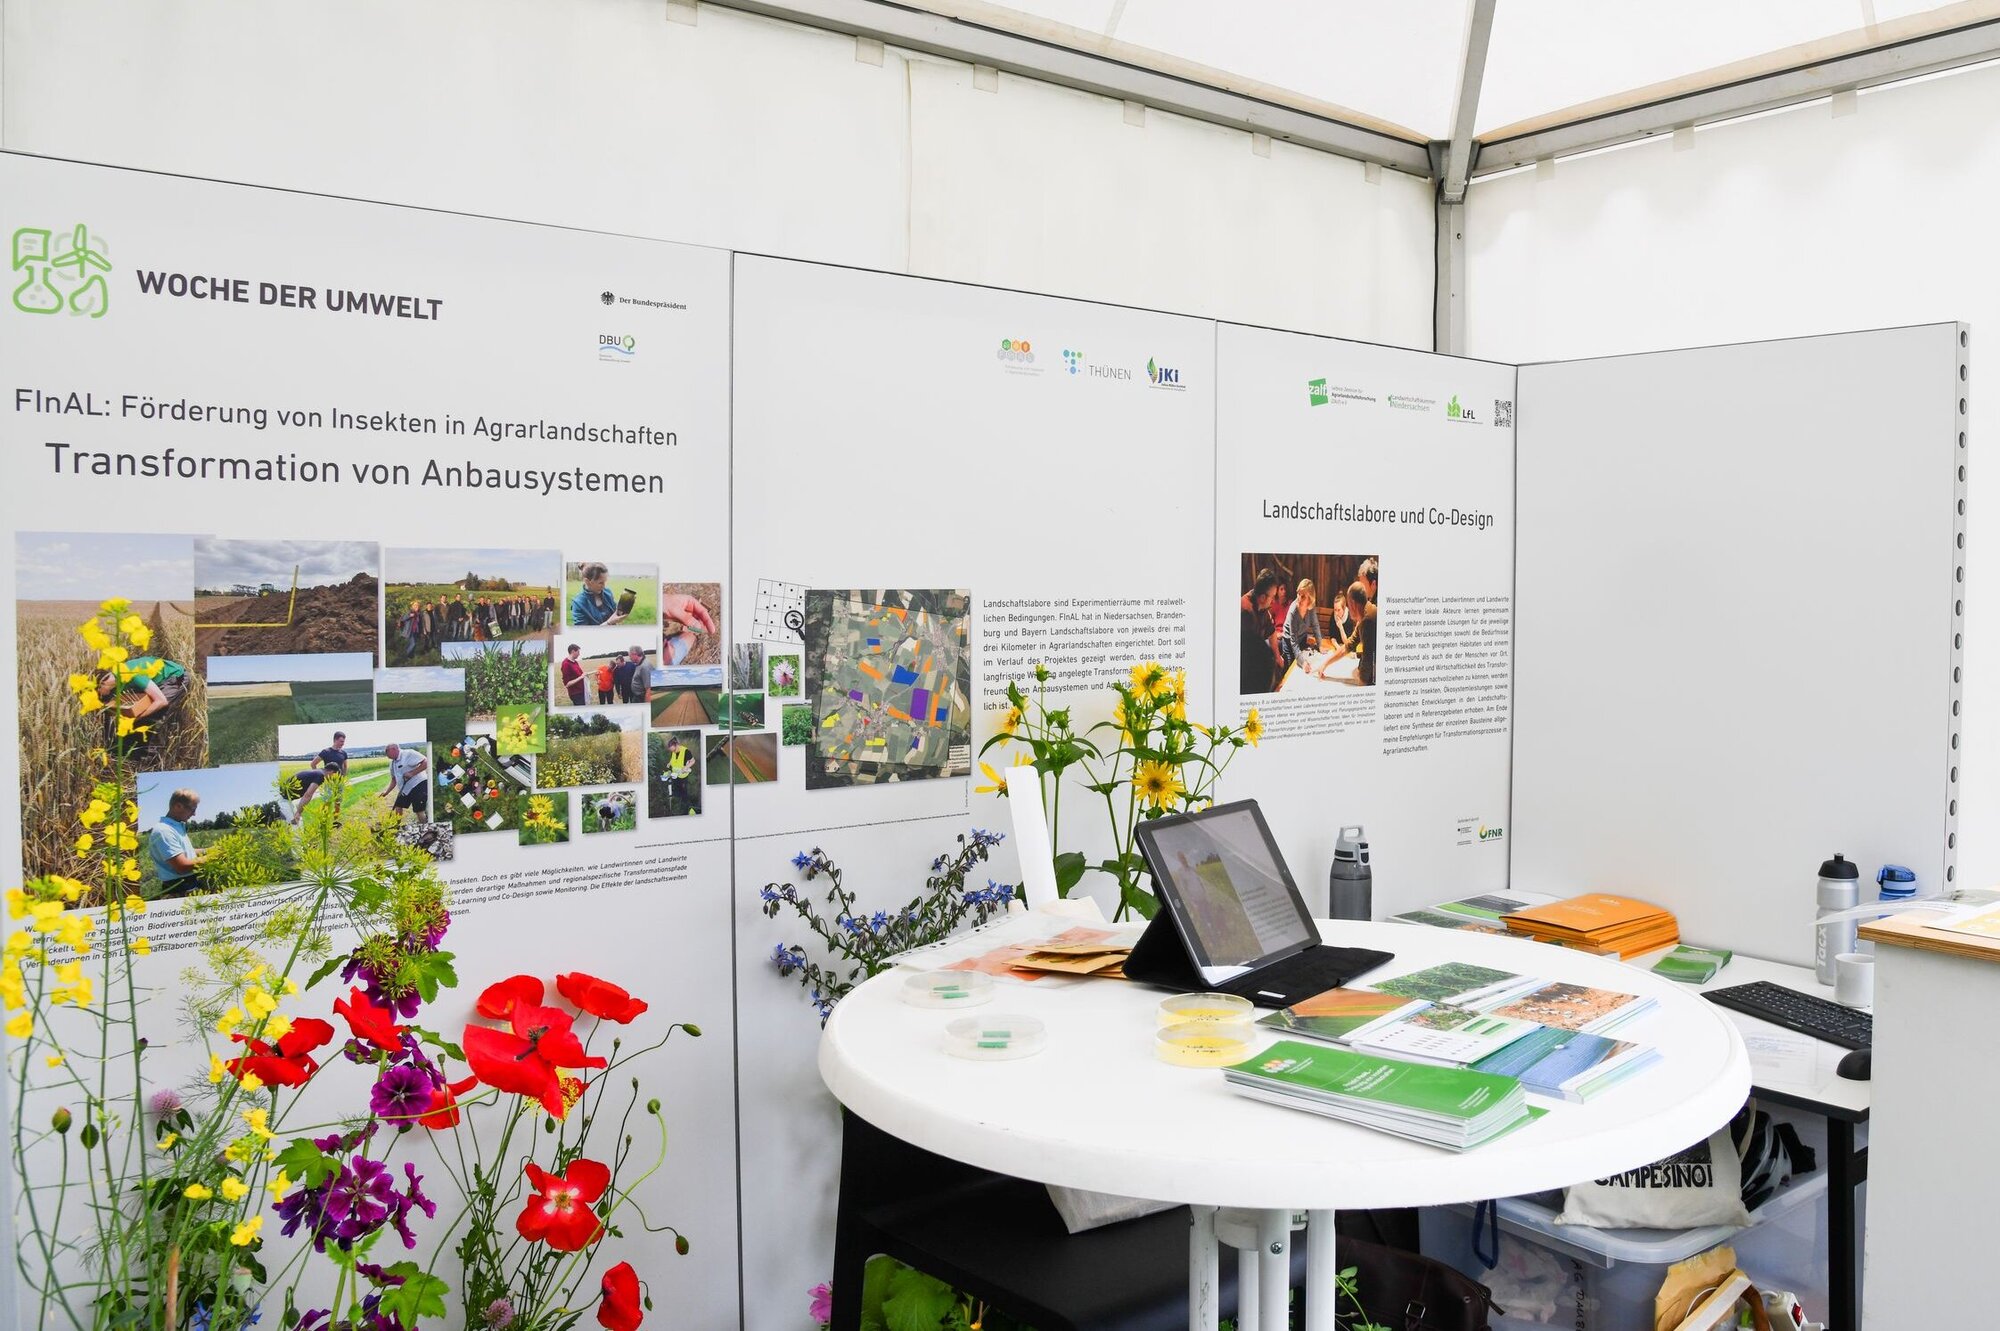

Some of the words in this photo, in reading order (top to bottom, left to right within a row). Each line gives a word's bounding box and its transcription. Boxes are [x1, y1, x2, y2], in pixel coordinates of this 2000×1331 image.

[136, 270, 250, 302] WOCHE
[259, 282, 317, 310] DER
[326, 290, 444, 321] UMWELT
[632, 299, 686, 310] Bundespräsident
[599, 334, 621, 346] DBU
[1089, 364, 1132, 380] THÜNEN
[15, 388, 110, 417] FInAL:
[122, 395, 268, 430] Förderung
[277, 409, 322, 428] von
[332, 408, 437, 434] Insekten
[446, 415, 466, 435] in
[473, 418, 678, 447] Agrarlandschaften
[1462, 409, 1476, 420] LfL
[45, 442, 340, 482] Transformation
[352, 462, 410, 485] von
[422, 459, 664, 495] Anbausystemen
[1262, 500, 1396, 522] Landschaftslabore
[1400, 507, 1424, 524] und
[1429, 508, 1494, 530] Co-Design
[983, 599, 1051, 608] Landschaftslabore
[1054, 599, 1069, 607] sind
[1072, 598, 1141, 608] Experimentierräume
[984, 614, 1006, 623] lichen
[1008, 613, 1056, 624] Bedingungen.
[1059, 612, 1079, 621] FInAL
[1082, 612, 1092, 621] hat
[1095, 612, 1101, 620] in
[1104, 612, 1154, 620] Niedersachsen,
[1156, 611, 1186, 619] Branden-
[983, 629, 1001, 639] burg
[1004, 628, 1018, 637] und
[1022, 628, 1047, 638] Bayern
[1050, 626, 1114, 636] Landschaftslabore
[1132, 625, 1155, 635] jeweils
[1158, 625, 1171, 633] drei
[983, 643, 998, 652] drei
[1001, 642, 1037, 651] Kilometer
[1039, 641, 1046, 650] in
[1049, 640, 1112, 651] Agrarlandschaften
[1115, 638, 1156, 649] eingerichtet.
[1158, 638, 1172, 646] Dort
[1174, 638, 1185, 646] soll
[983, 657, 993, 666] im
[997, 657, 1024, 666] Verlauf
[1027, 656, 1040, 665] des
[1044, 655, 1078, 665] Projektes
[1081, 654, 1106, 665] gezeigt
[1109, 653, 1136, 662] werden,
[1139, 652, 1155, 660] dass
[1175, 651, 1186, 659] auf
[983, 672, 1026, 683] langfristige
[1058, 669, 1092, 679] angelegte
[1091, 682, 1104, 690] und
[983, 702, 998, 711] lich
[1488, 828, 1503, 838] FNR
[509, 872, 522, 880] gibt
[541, 866, 586, 876] Möglichkeiten,
[600, 860, 644, 869] Landwirtinnen
[658, 856, 687, 864] Landwirte
[230, 912, 258, 921] stärken
[475, 884, 505, 893] derartige
[507, 880, 546, 889] Maßnahmen
[563, 872, 621, 884] regionalspezifische
[624, 865, 687, 876] Transformationspfade
[168, 930, 198, 939] werden
[488, 893, 501, 902] und
[501, 891, 534, 900] Co-Design
[554, 885, 589, 894] Monitoring.
[635, 875, 688, 885] landschaftsweiten
[1816, 925, 1826, 966] Tacx
